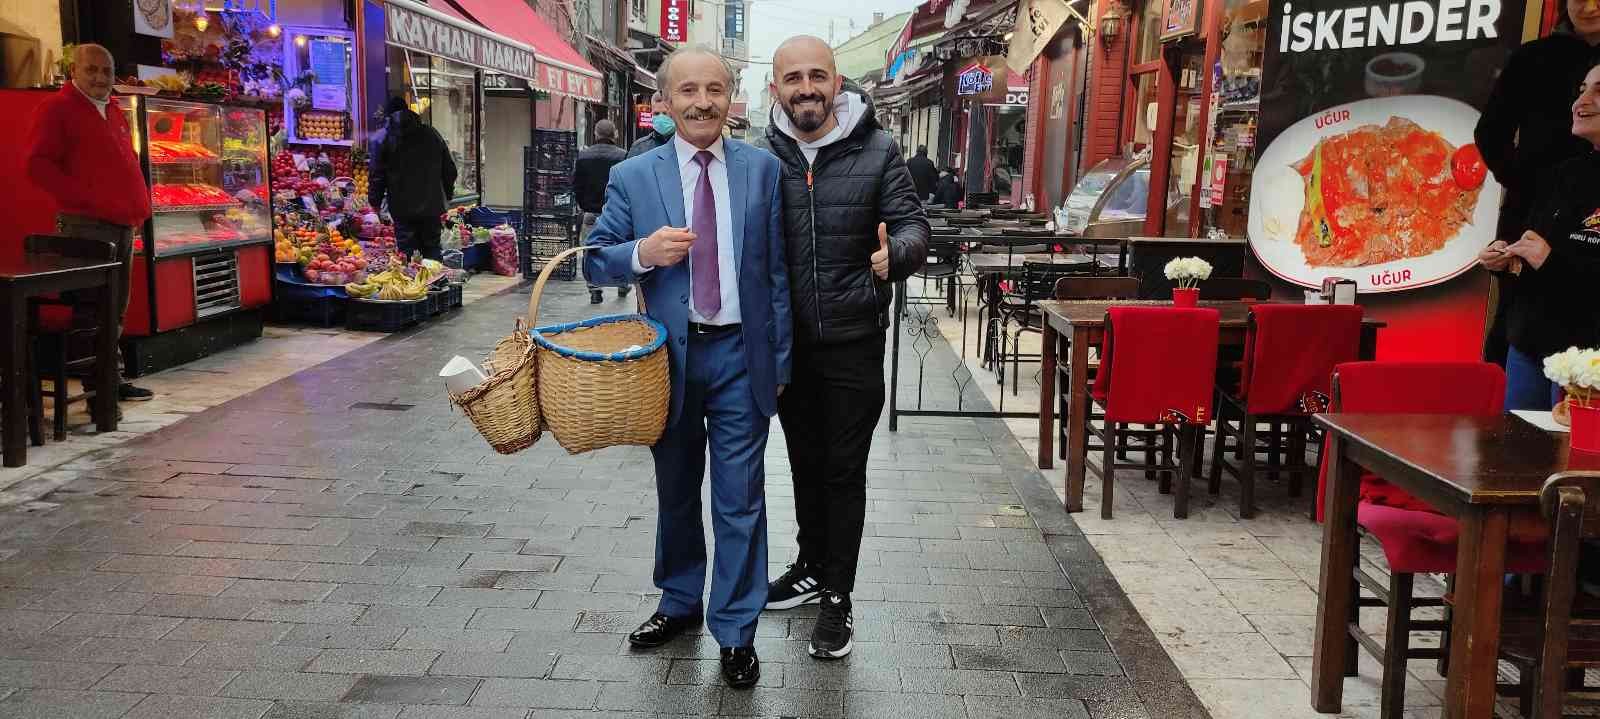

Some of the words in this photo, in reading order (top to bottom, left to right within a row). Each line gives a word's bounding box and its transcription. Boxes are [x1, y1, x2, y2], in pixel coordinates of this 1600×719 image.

[392, 10, 474, 60] KAYHAN
[1280, 0, 1502, 52] İSKENDER
[1315, 110, 1350, 129] UĞUR
[1371, 270, 1412, 286] UĞUR
